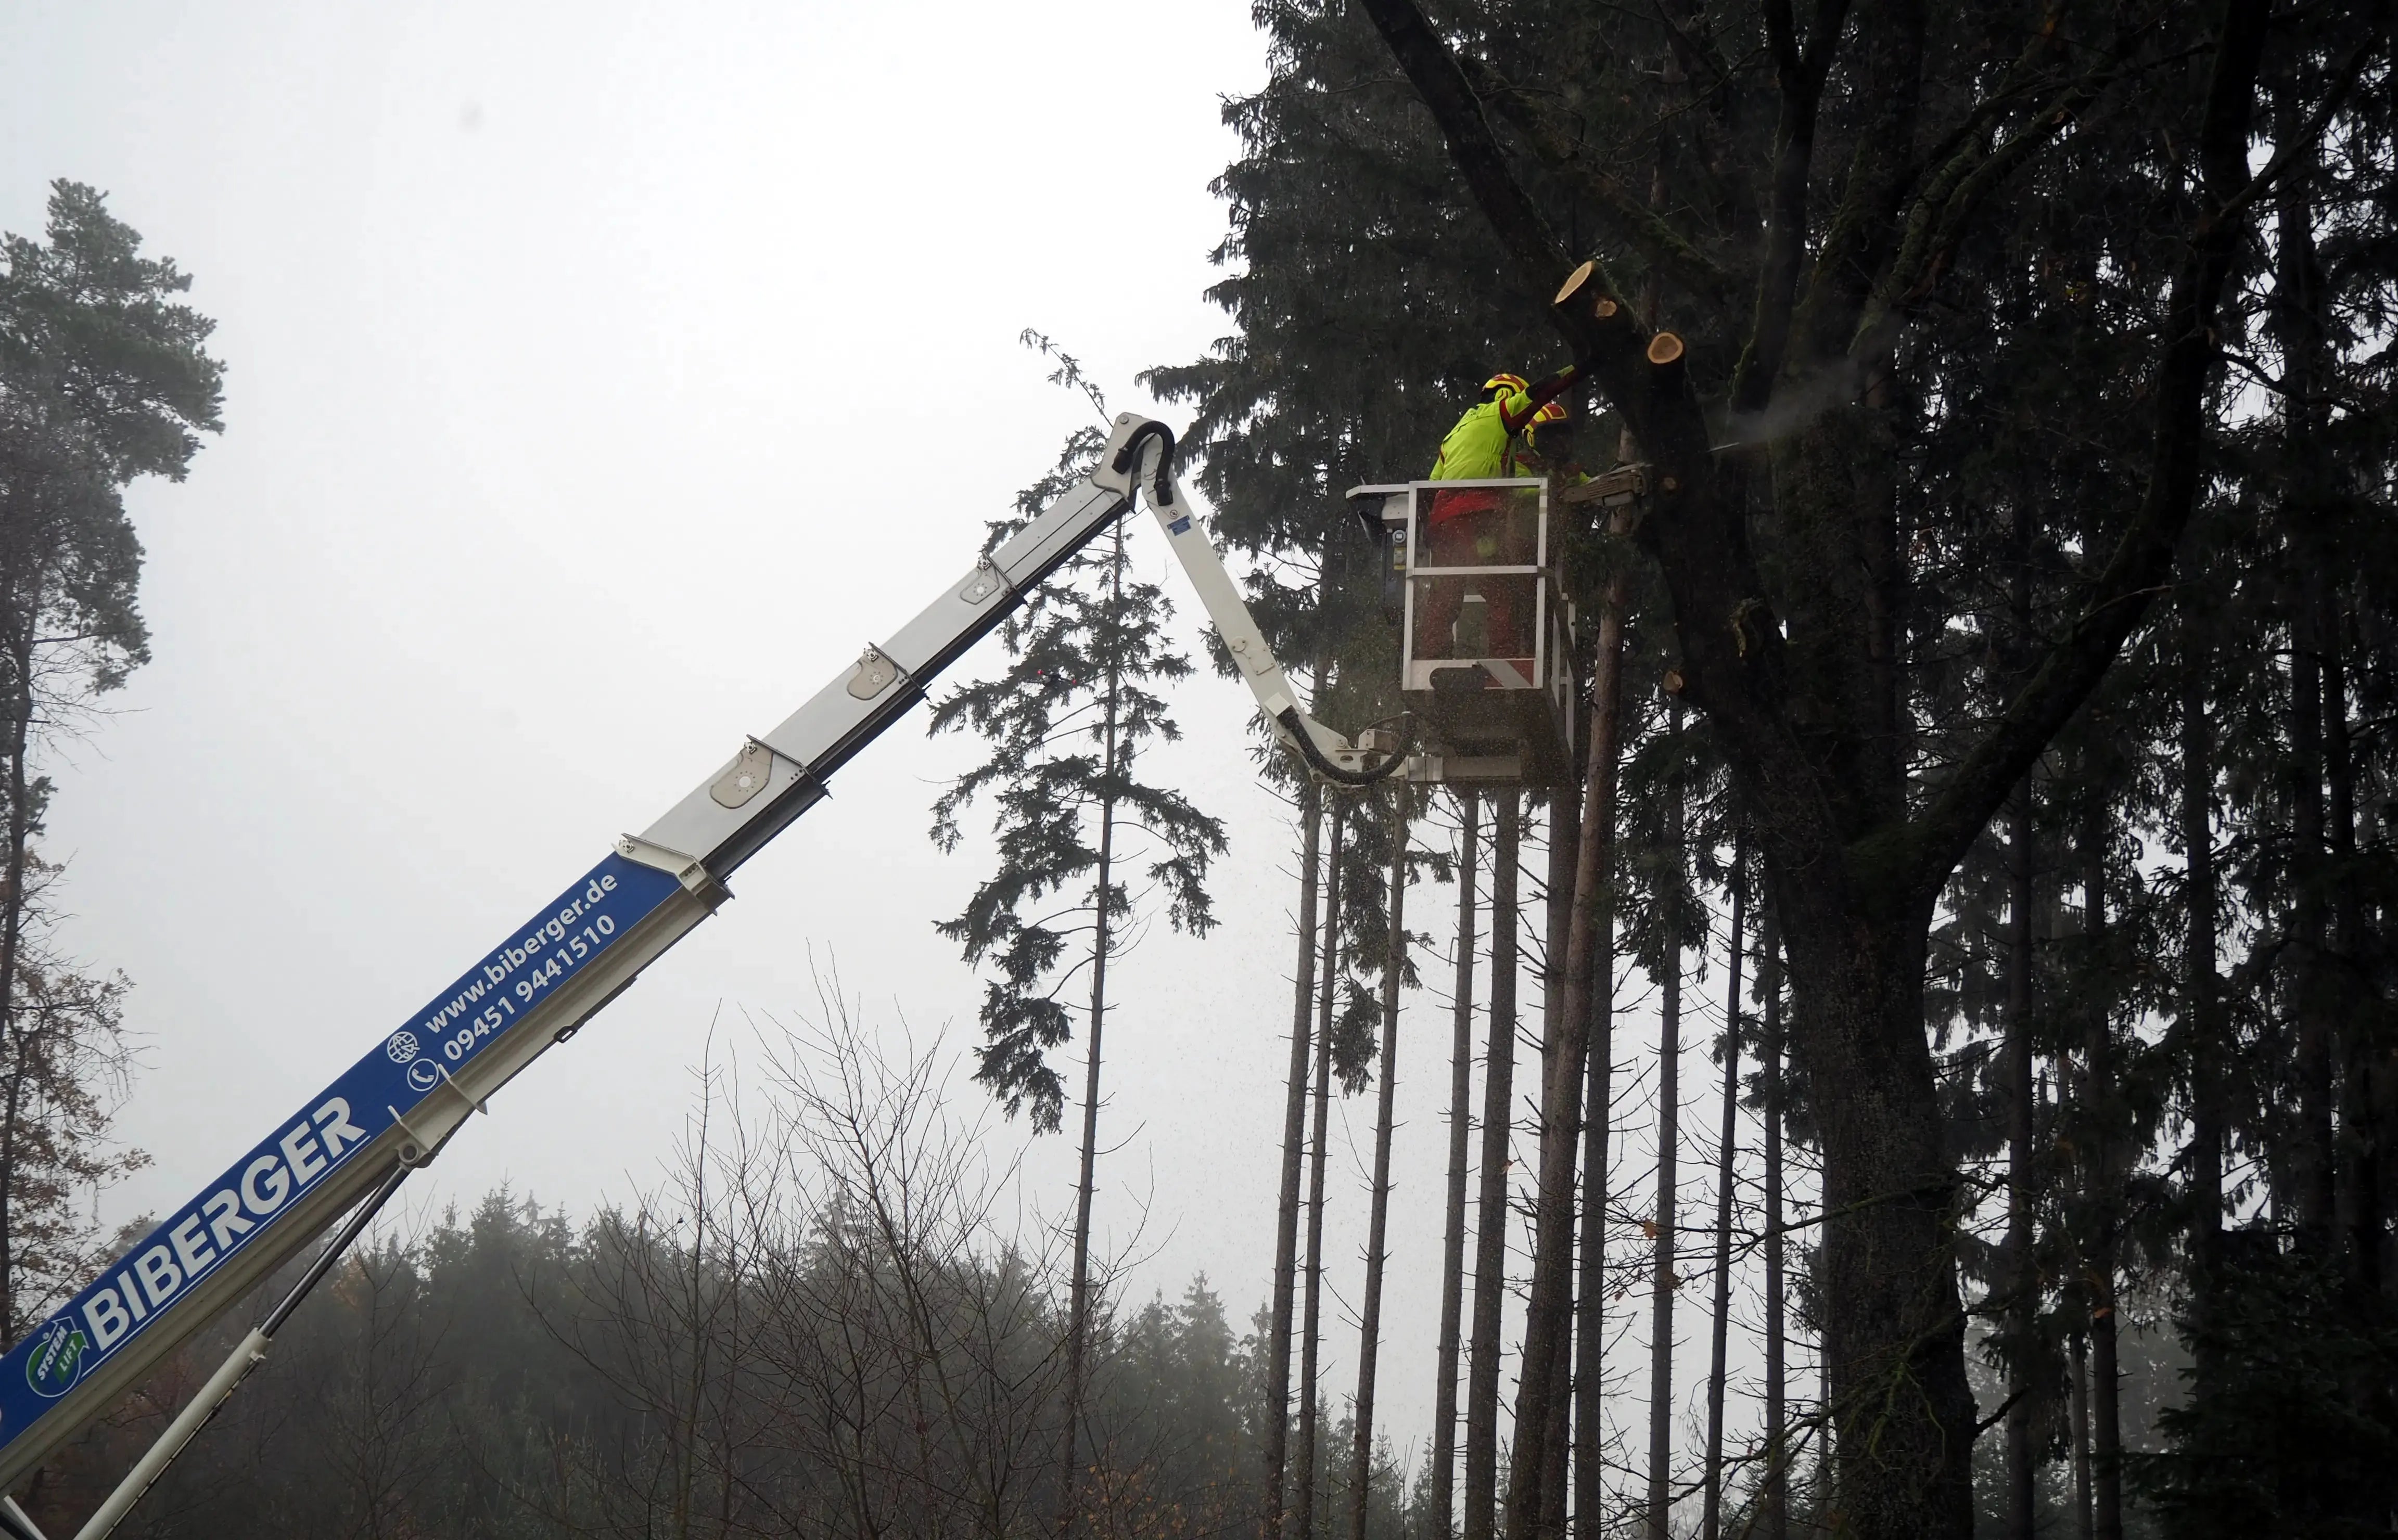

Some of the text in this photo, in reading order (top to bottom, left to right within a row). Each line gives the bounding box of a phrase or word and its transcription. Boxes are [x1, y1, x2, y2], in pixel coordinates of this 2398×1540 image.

[425, 872, 618, 1034] www.biberger.de
[443, 915, 615, 1061] 09451 9441510
[82, 1097, 366, 1352] BIBERGER
[37, 1325, 68, 1381] SYSTEM
[59, 1339, 77, 1372] LIFT
